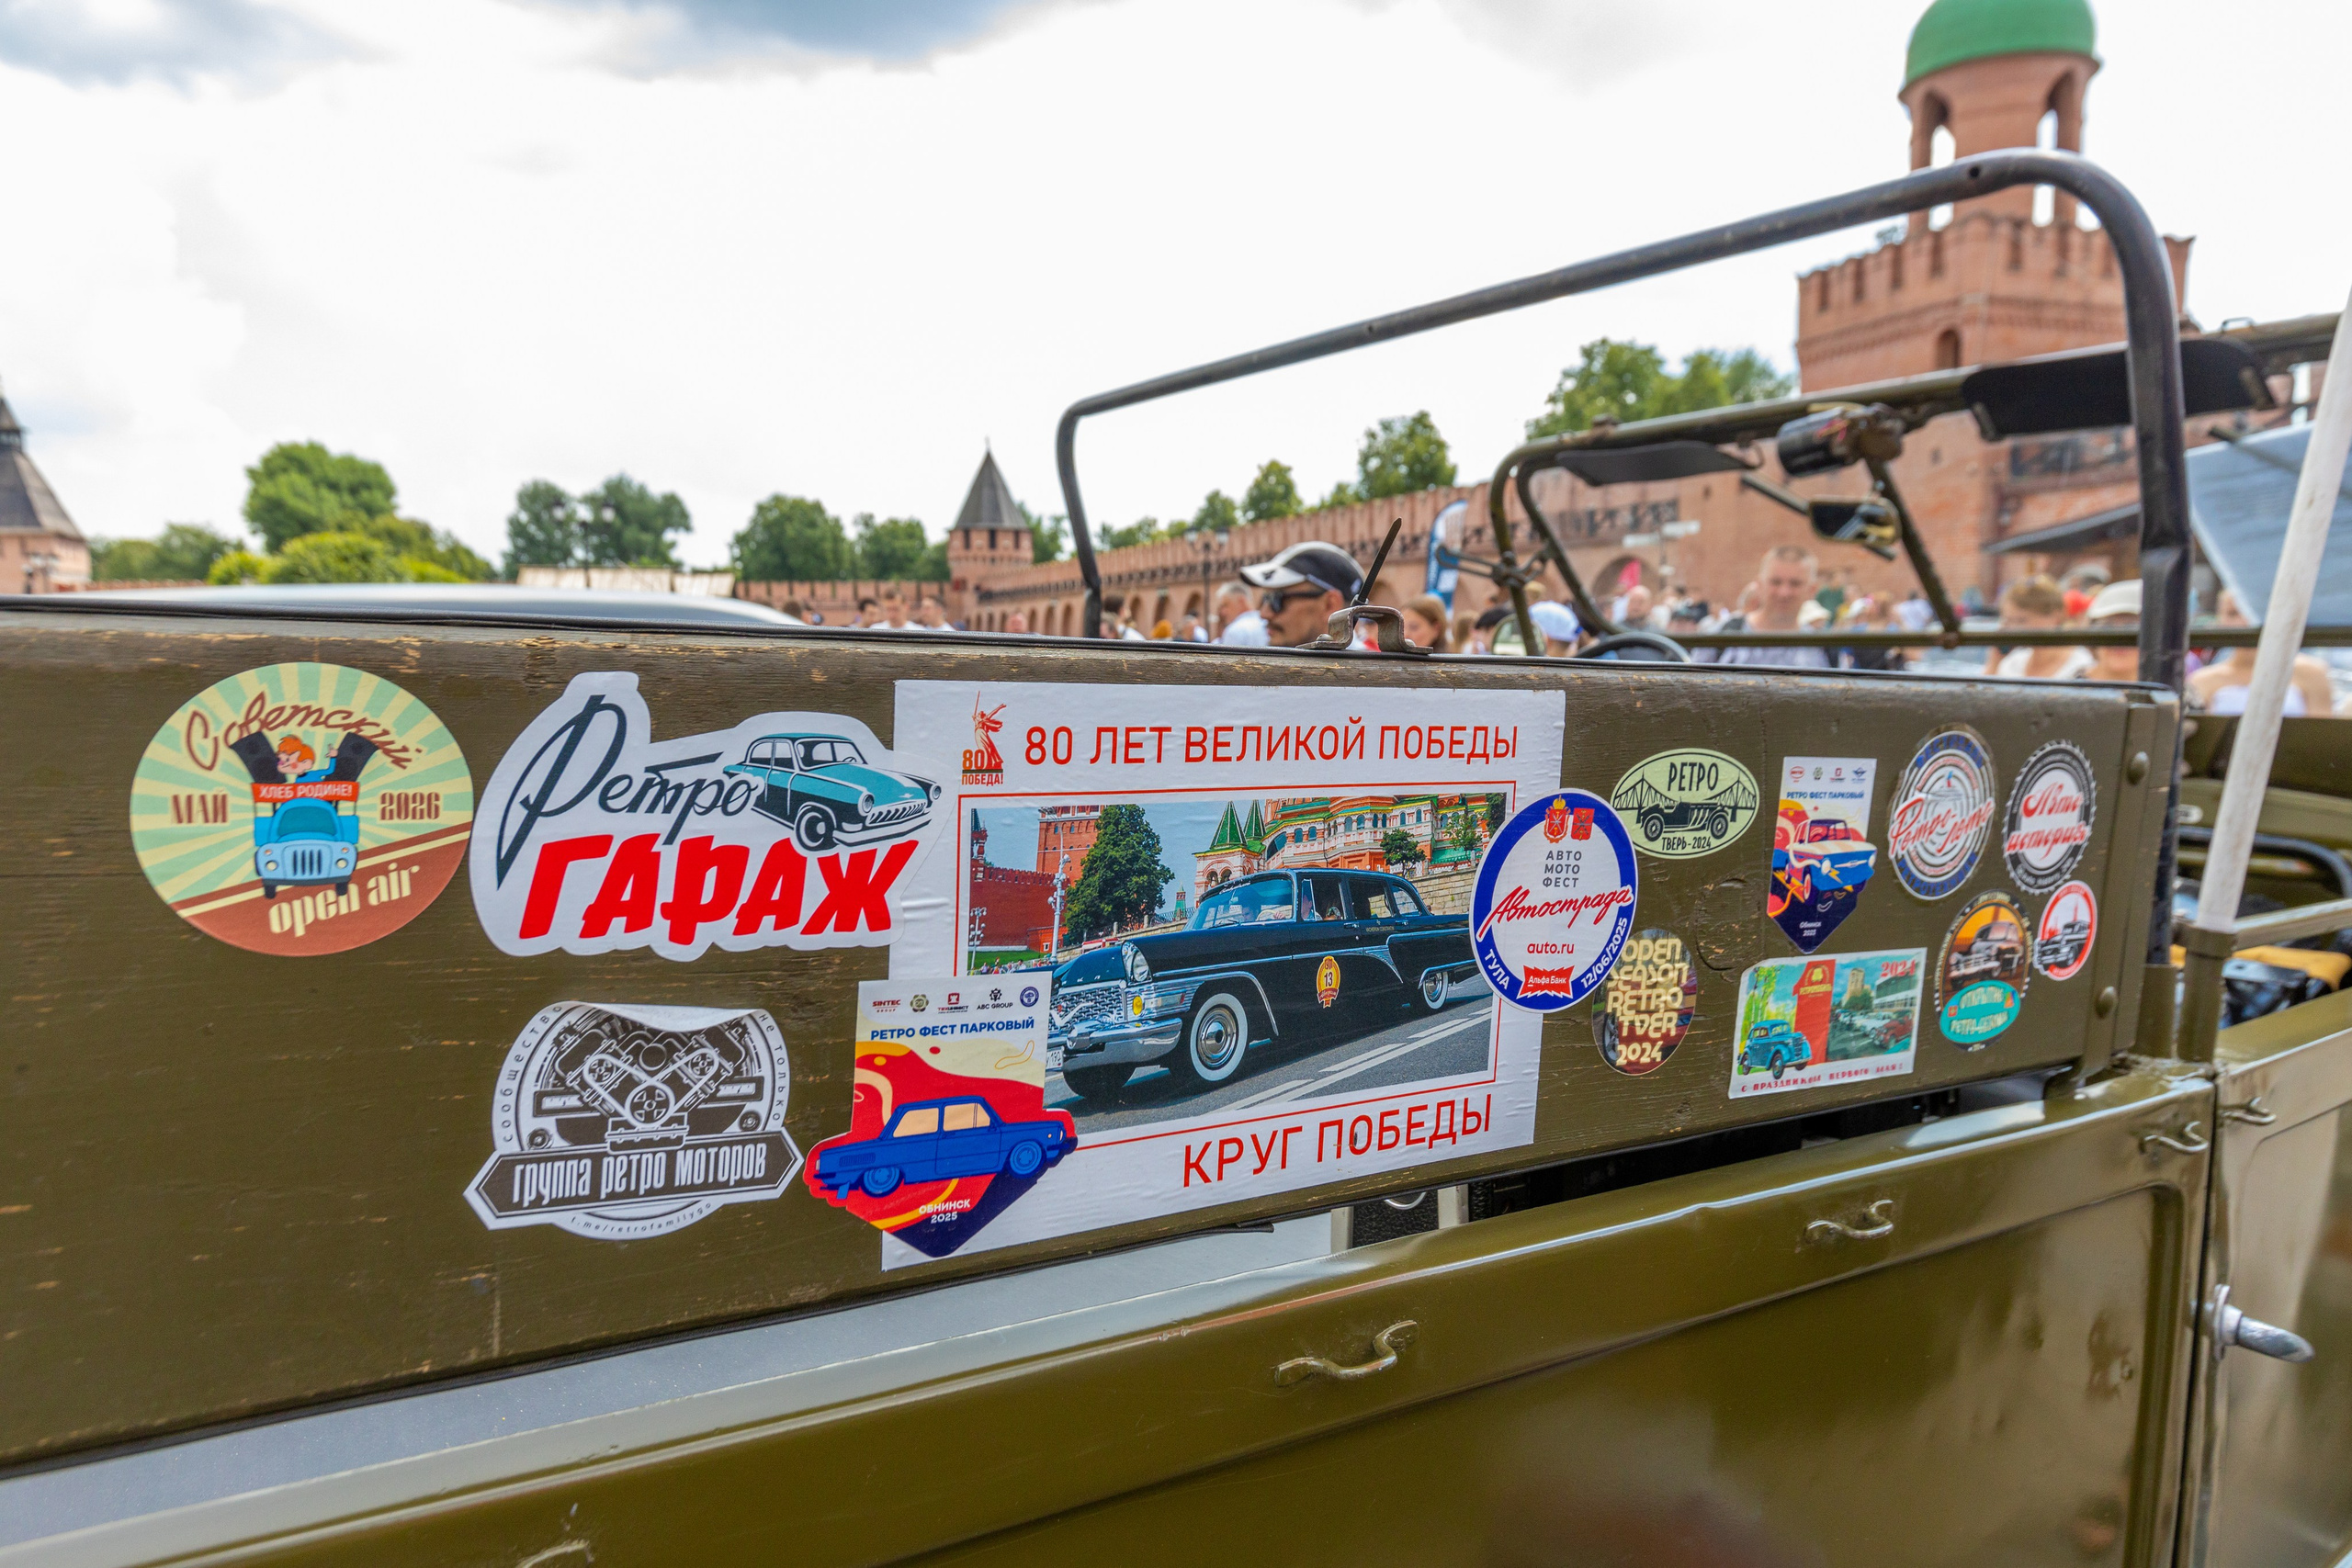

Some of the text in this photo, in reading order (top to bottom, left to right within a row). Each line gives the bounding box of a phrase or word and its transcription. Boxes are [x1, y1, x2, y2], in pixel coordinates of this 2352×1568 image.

[186, 691, 423, 771] Советский
[1024, 716, 1519, 765] 80 ЛЕТ ВЕЛИКОЙ ПОБЕДЫ
[961, 749, 985, 770] 80
[961, 773, 1004, 786] ПОБЕДА!
[1668, 762, 1719, 792] РЕТРО
[259, 784, 353, 799] ХЛЕБ РОДИНЕ!
[496, 694, 759, 890] Ретро
[171, 790, 229, 824] МАЙ
[379, 792, 441, 820] 2026
[1544, 863, 1580, 874] МОТО
[1546, 850, 1582, 861] АВТО
[519, 833, 919, 945] ГАРАЖ
[1543, 877, 1578, 888] ФЕСТ
[268, 863, 421, 937] open air
[1478, 885, 1632, 939] Автострада
[1527, 942, 1575, 953] auto.ru
[1580, 917, 1628, 988] 12/06/2025
[1324, 972, 1333, 987] 13
[1484, 949, 1510, 990] ТУЛА
[1528, 975, 1567, 987] Альфа Банк
[1880, 960, 1917, 978] 2024
[1607, 987, 1684, 1017] RETRO
[871, 1016, 1035, 1041] РЕТРО ФЕСТ ПАРКОВЫЙ
[1618, 1010, 1679, 1038] TVER
[1616, 1041, 1664, 1066] 2024
[500, 1006, 562, 1143] сообщество
[772, 1044, 787, 1122] только
[1182, 1093, 1492, 1188] КРУГ ПОБЕДЫ
[919, 1199, 971, 1214] ОБНИНСК
[930, 1212, 958, 1224] 2025
